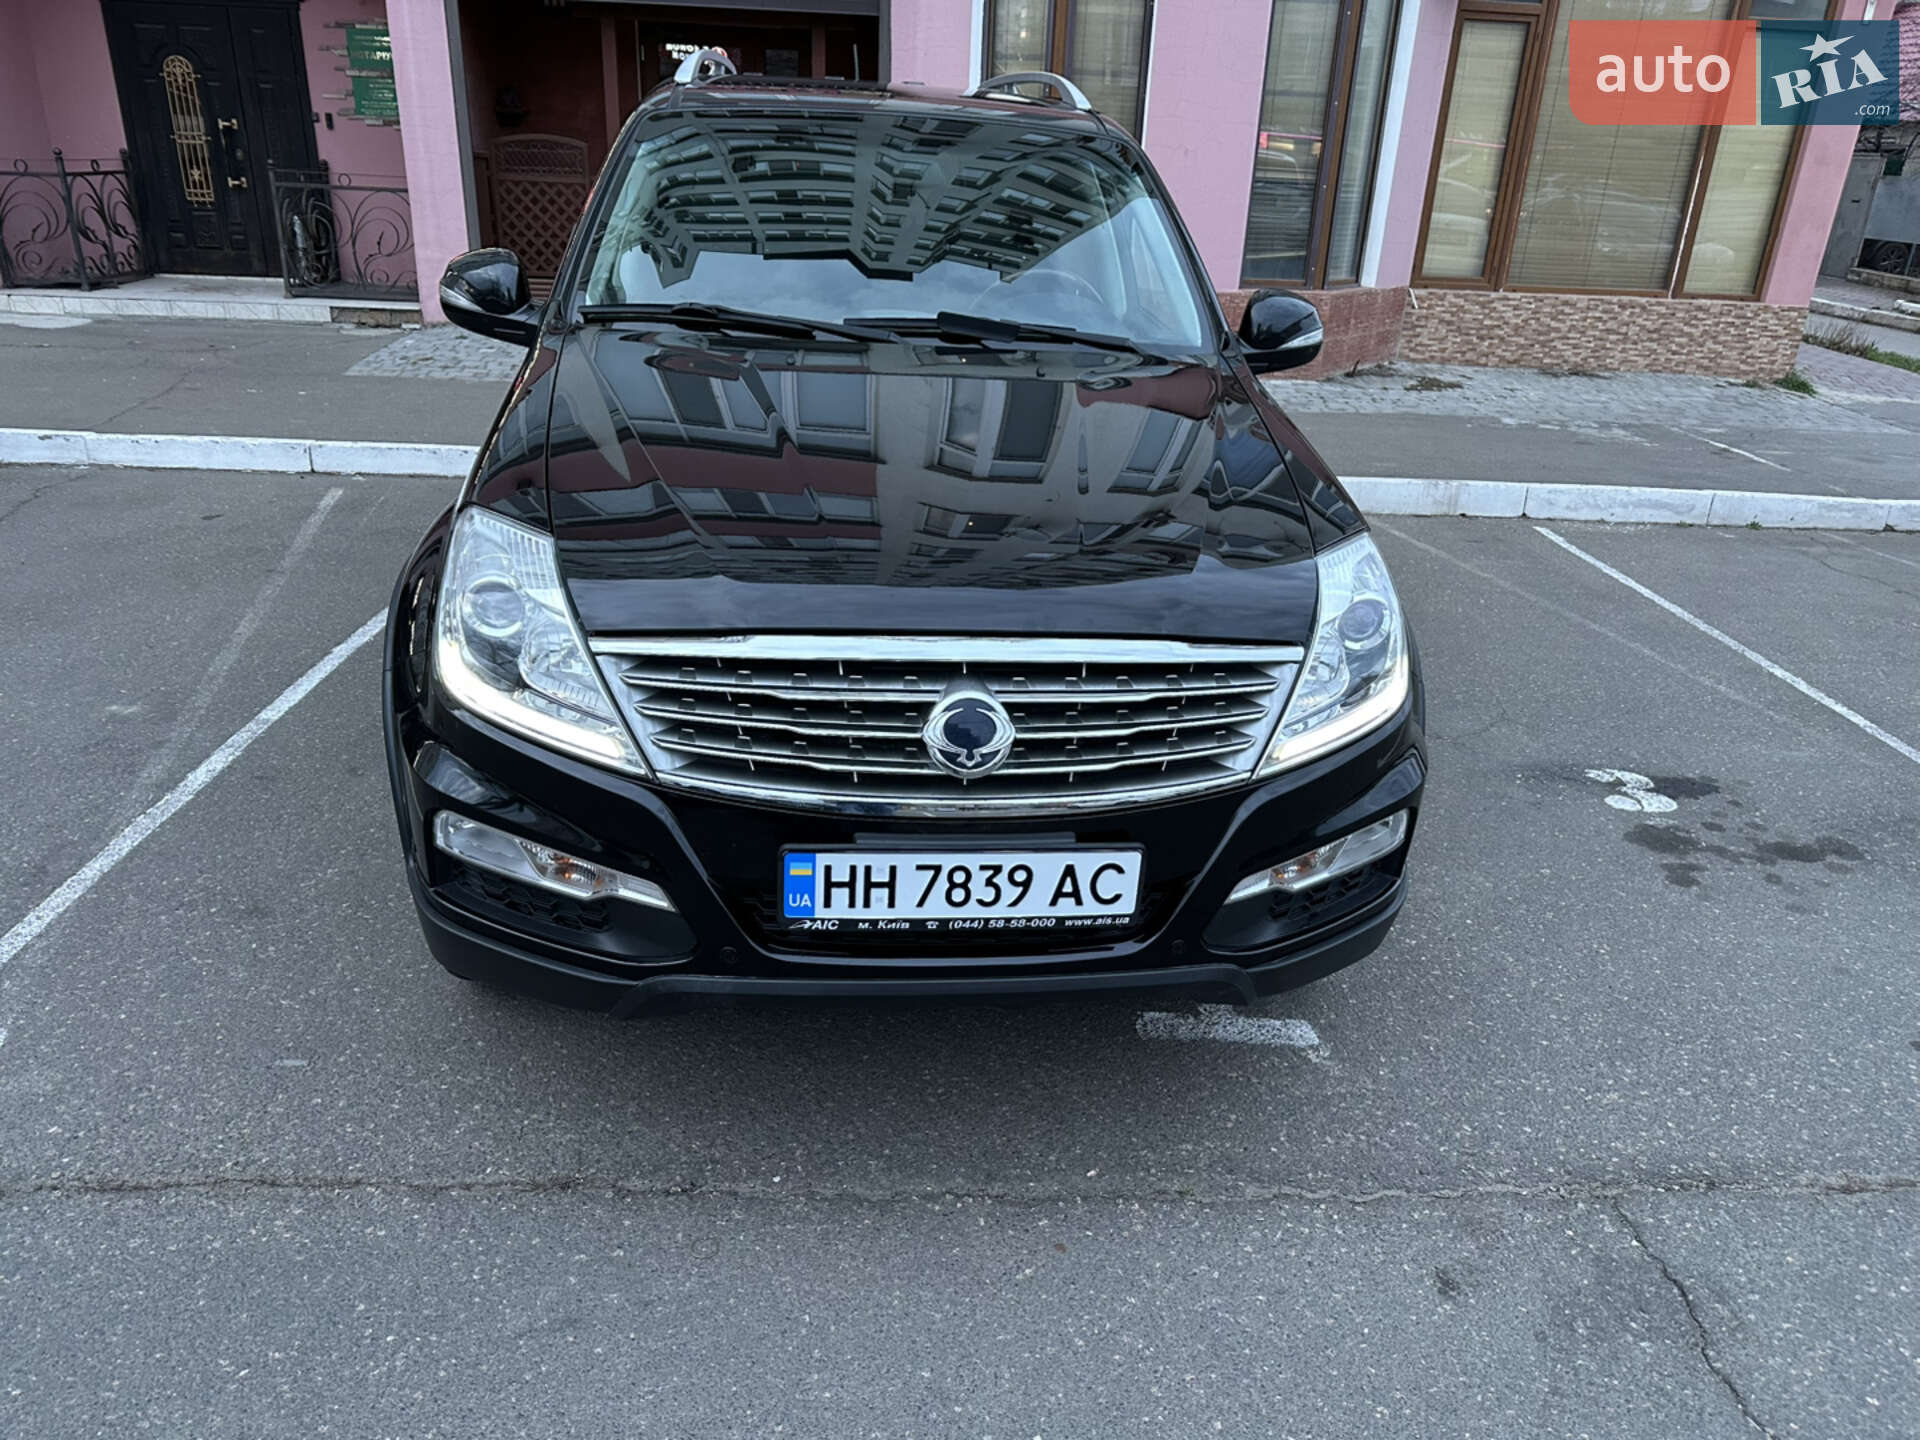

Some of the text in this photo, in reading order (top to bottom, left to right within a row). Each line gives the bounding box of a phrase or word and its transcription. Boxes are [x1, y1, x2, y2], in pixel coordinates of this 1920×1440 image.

[822, 863, 1126, 909] HH 7839 AC
[788, 893, 812, 908] UA
[949, 919, 984, 929] (044)
[987, 917, 1056, 928] 58-58-000
[1064, 916, 1131, 927] www.ais.ua
